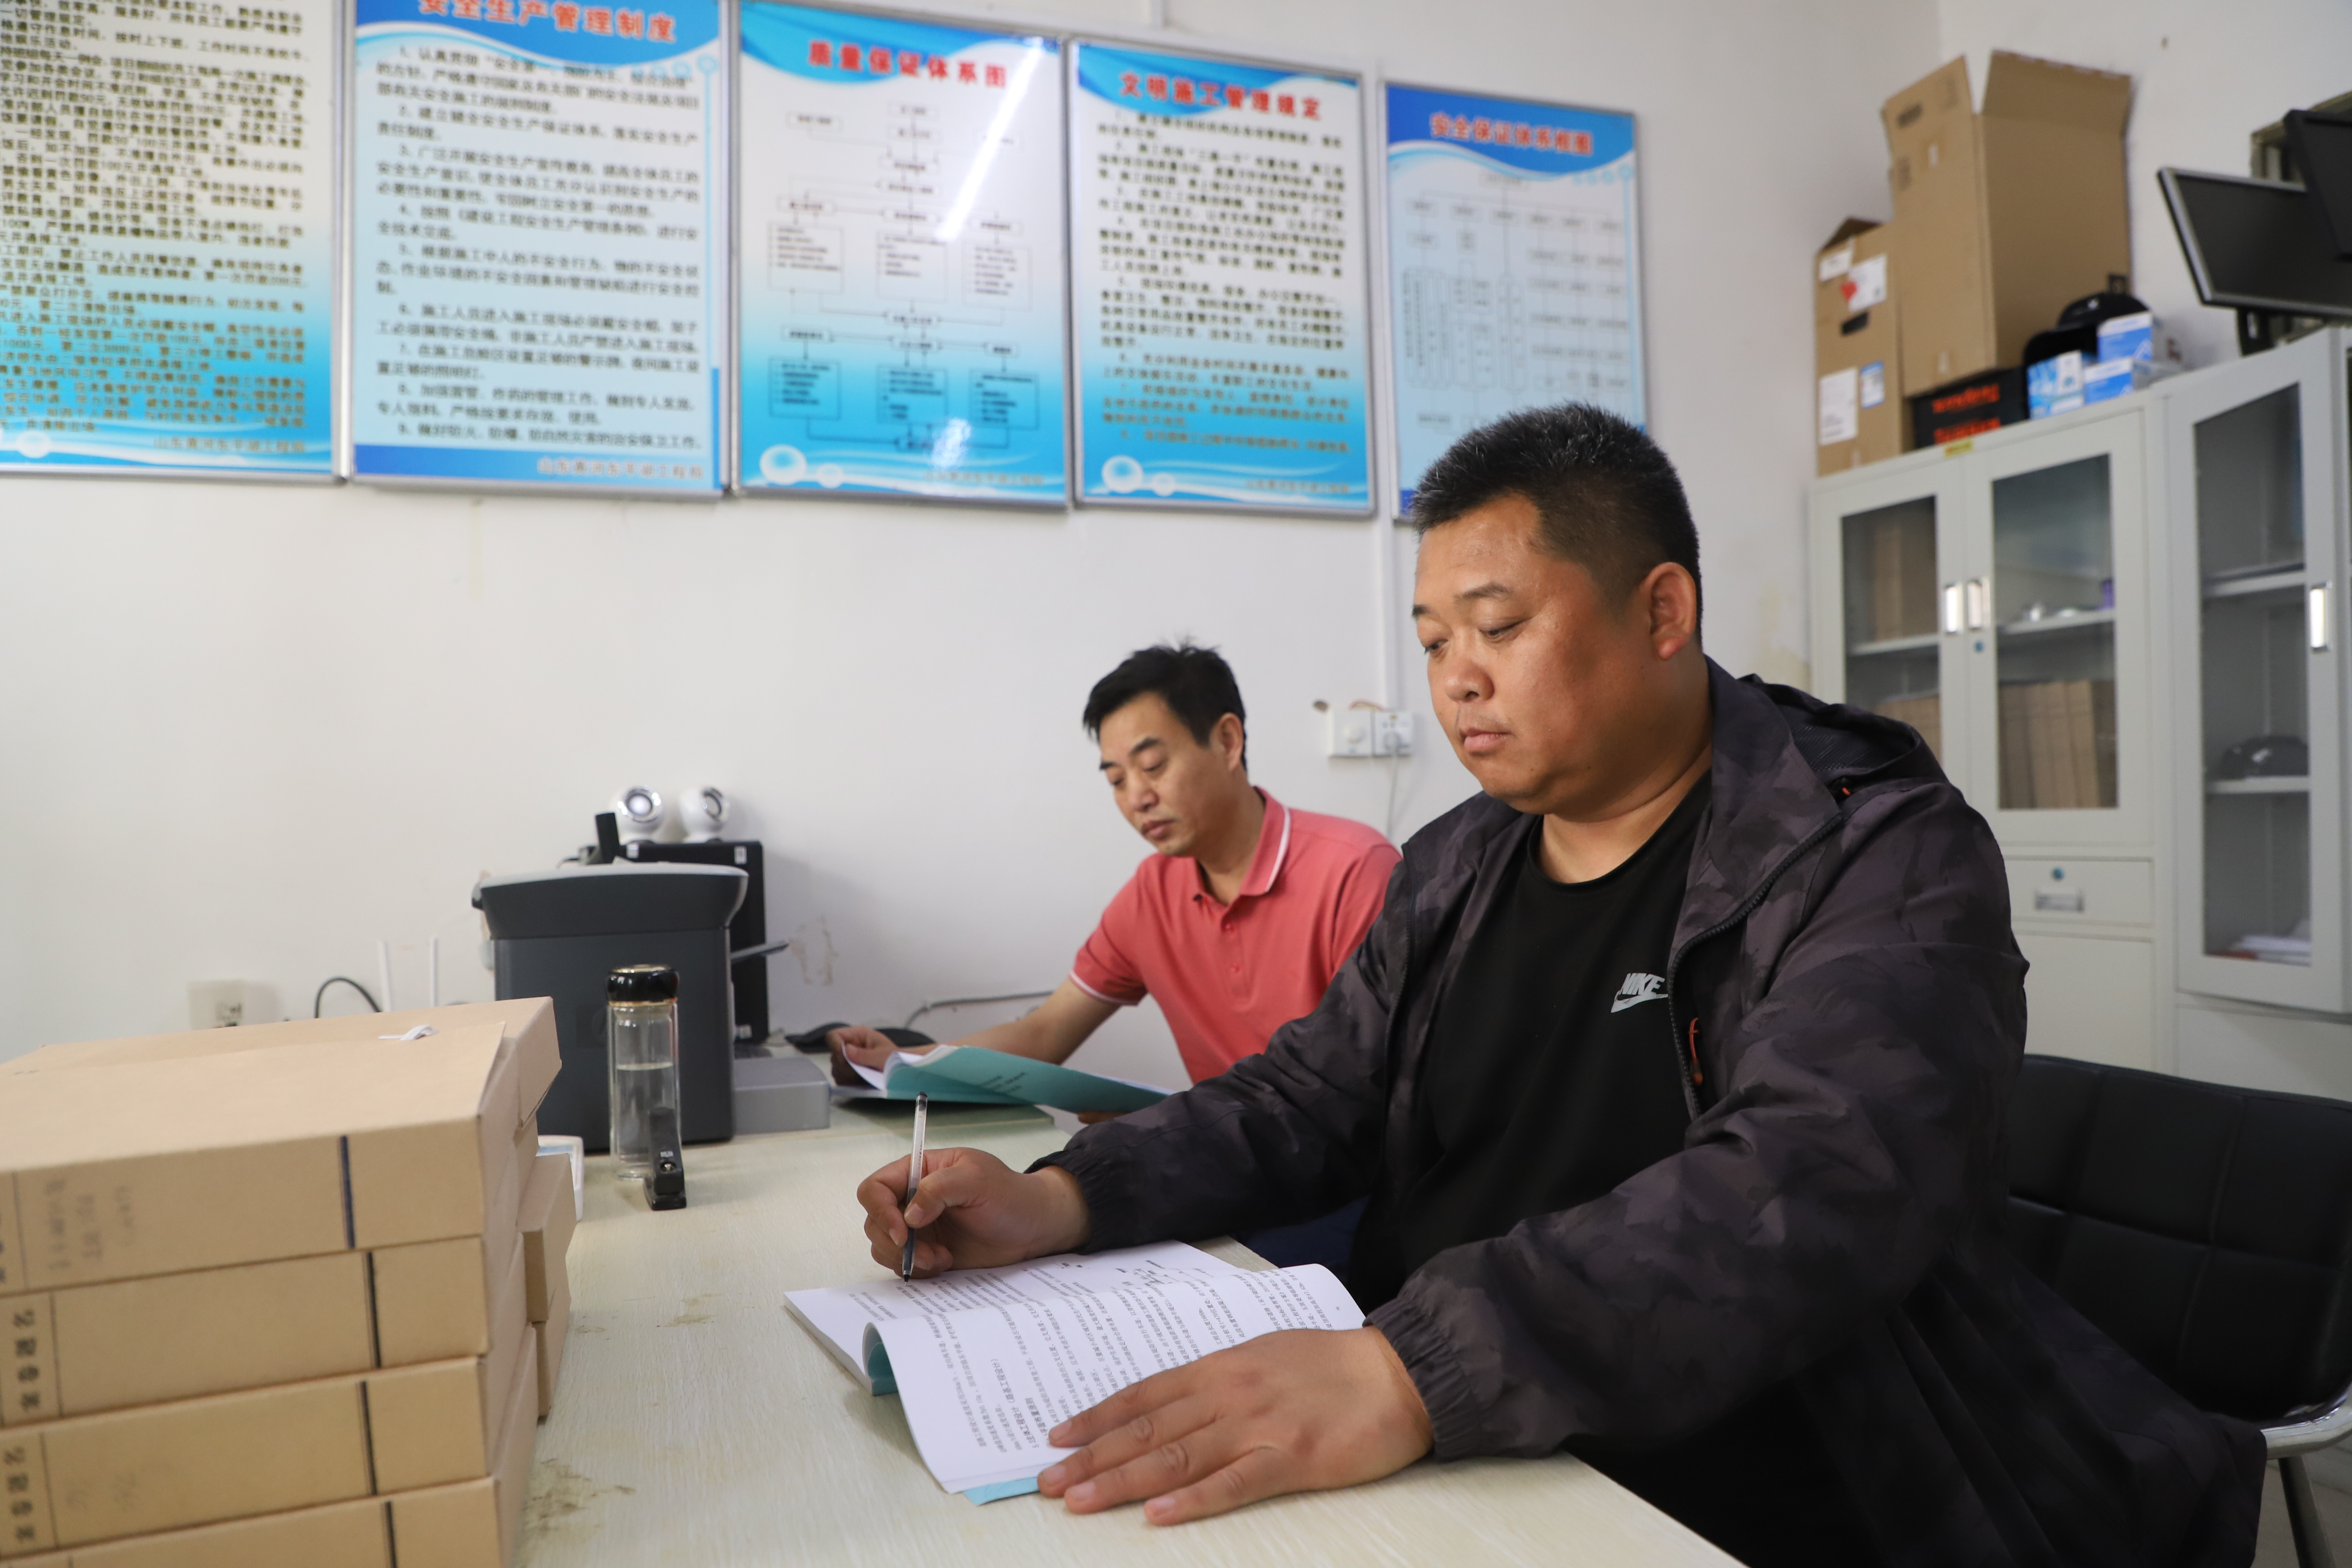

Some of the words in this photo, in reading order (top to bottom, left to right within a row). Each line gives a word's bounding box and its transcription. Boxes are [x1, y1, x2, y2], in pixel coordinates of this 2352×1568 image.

[807, 39, 1007, 89] 质量保证体系图
[1119, 70, 1321, 121] 文明施工管理规定
[1620, 972, 1665, 995] NIKE
[1024, 1396, 1053, 1445] ..1平面布置原则
